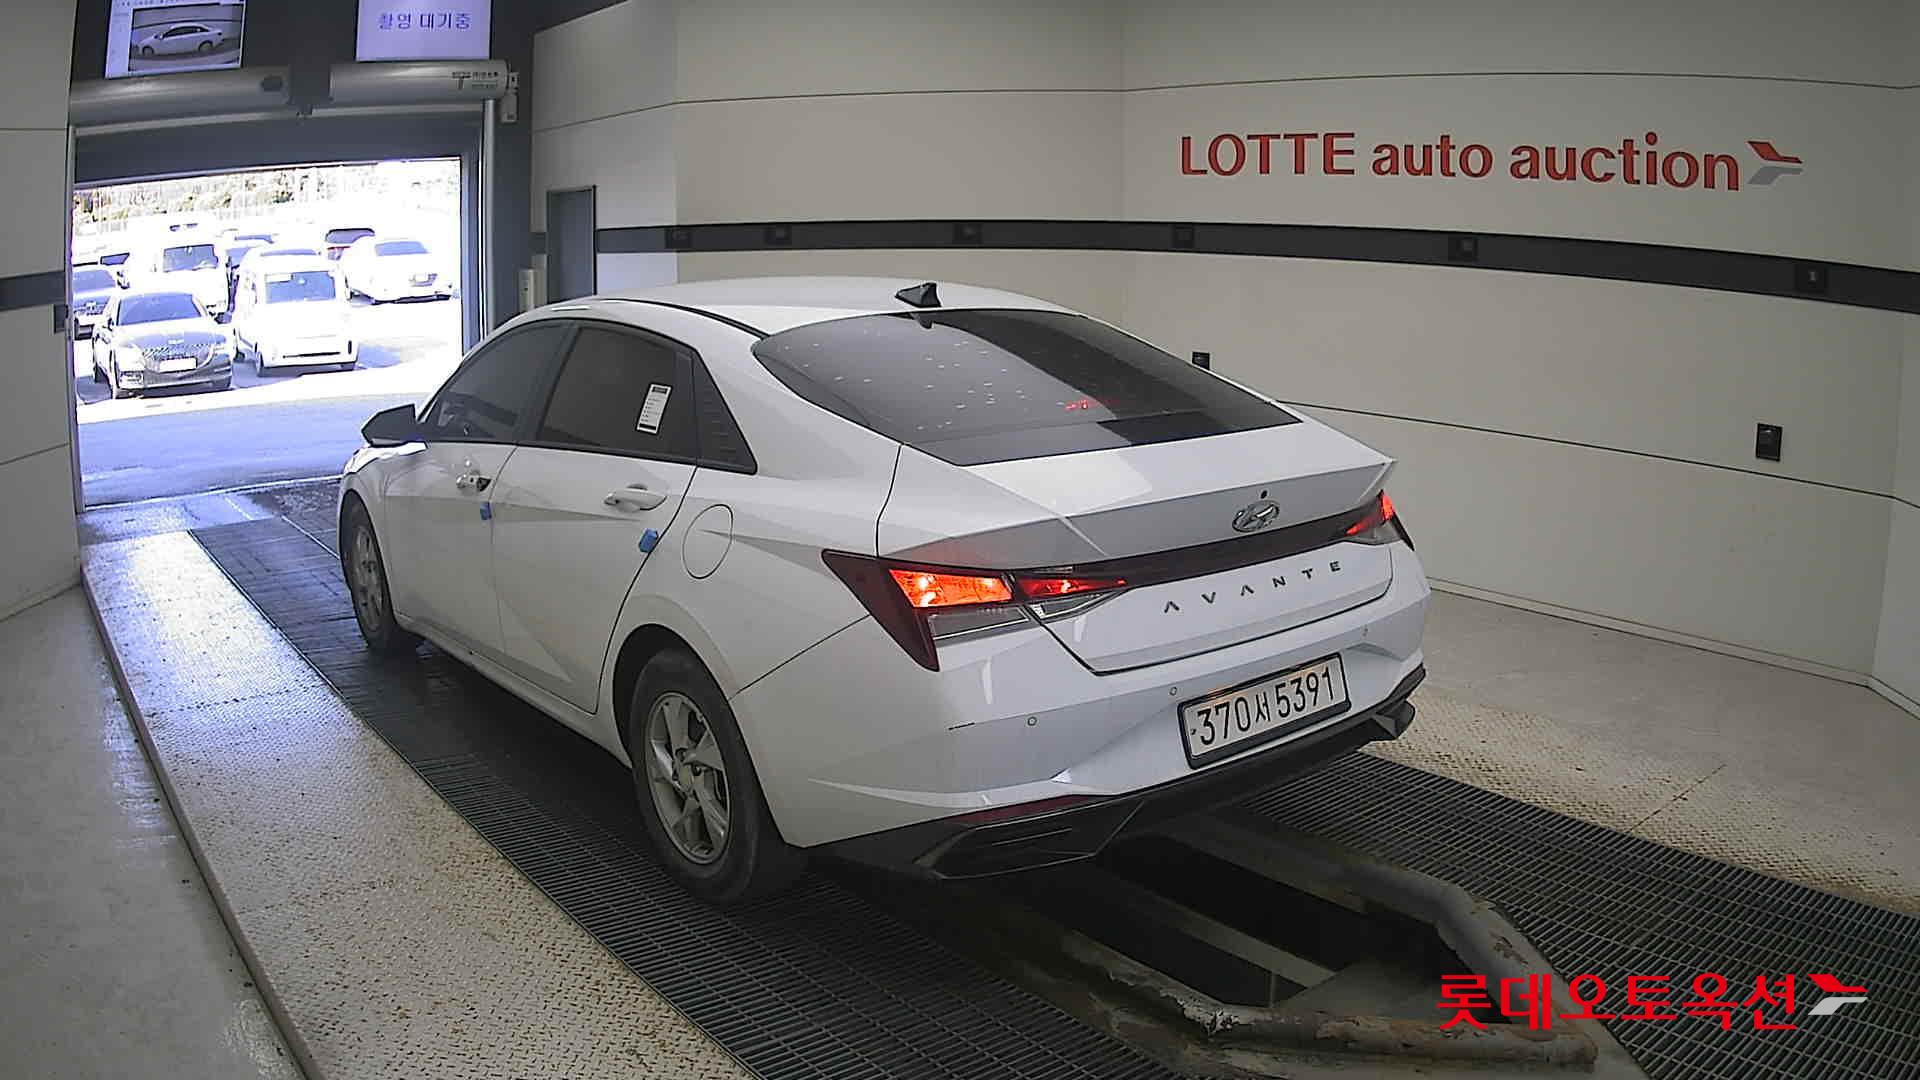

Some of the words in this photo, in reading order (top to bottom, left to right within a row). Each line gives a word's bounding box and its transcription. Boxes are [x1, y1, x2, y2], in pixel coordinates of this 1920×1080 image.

[419, 12, 471, 31] 대기중
[1181, 131, 1356, 176] LOTTE
[1371, 134, 1495, 179] auto
[1509, 130, 1741, 192] auction
[1164, 560, 1341, 614] AVANTE
